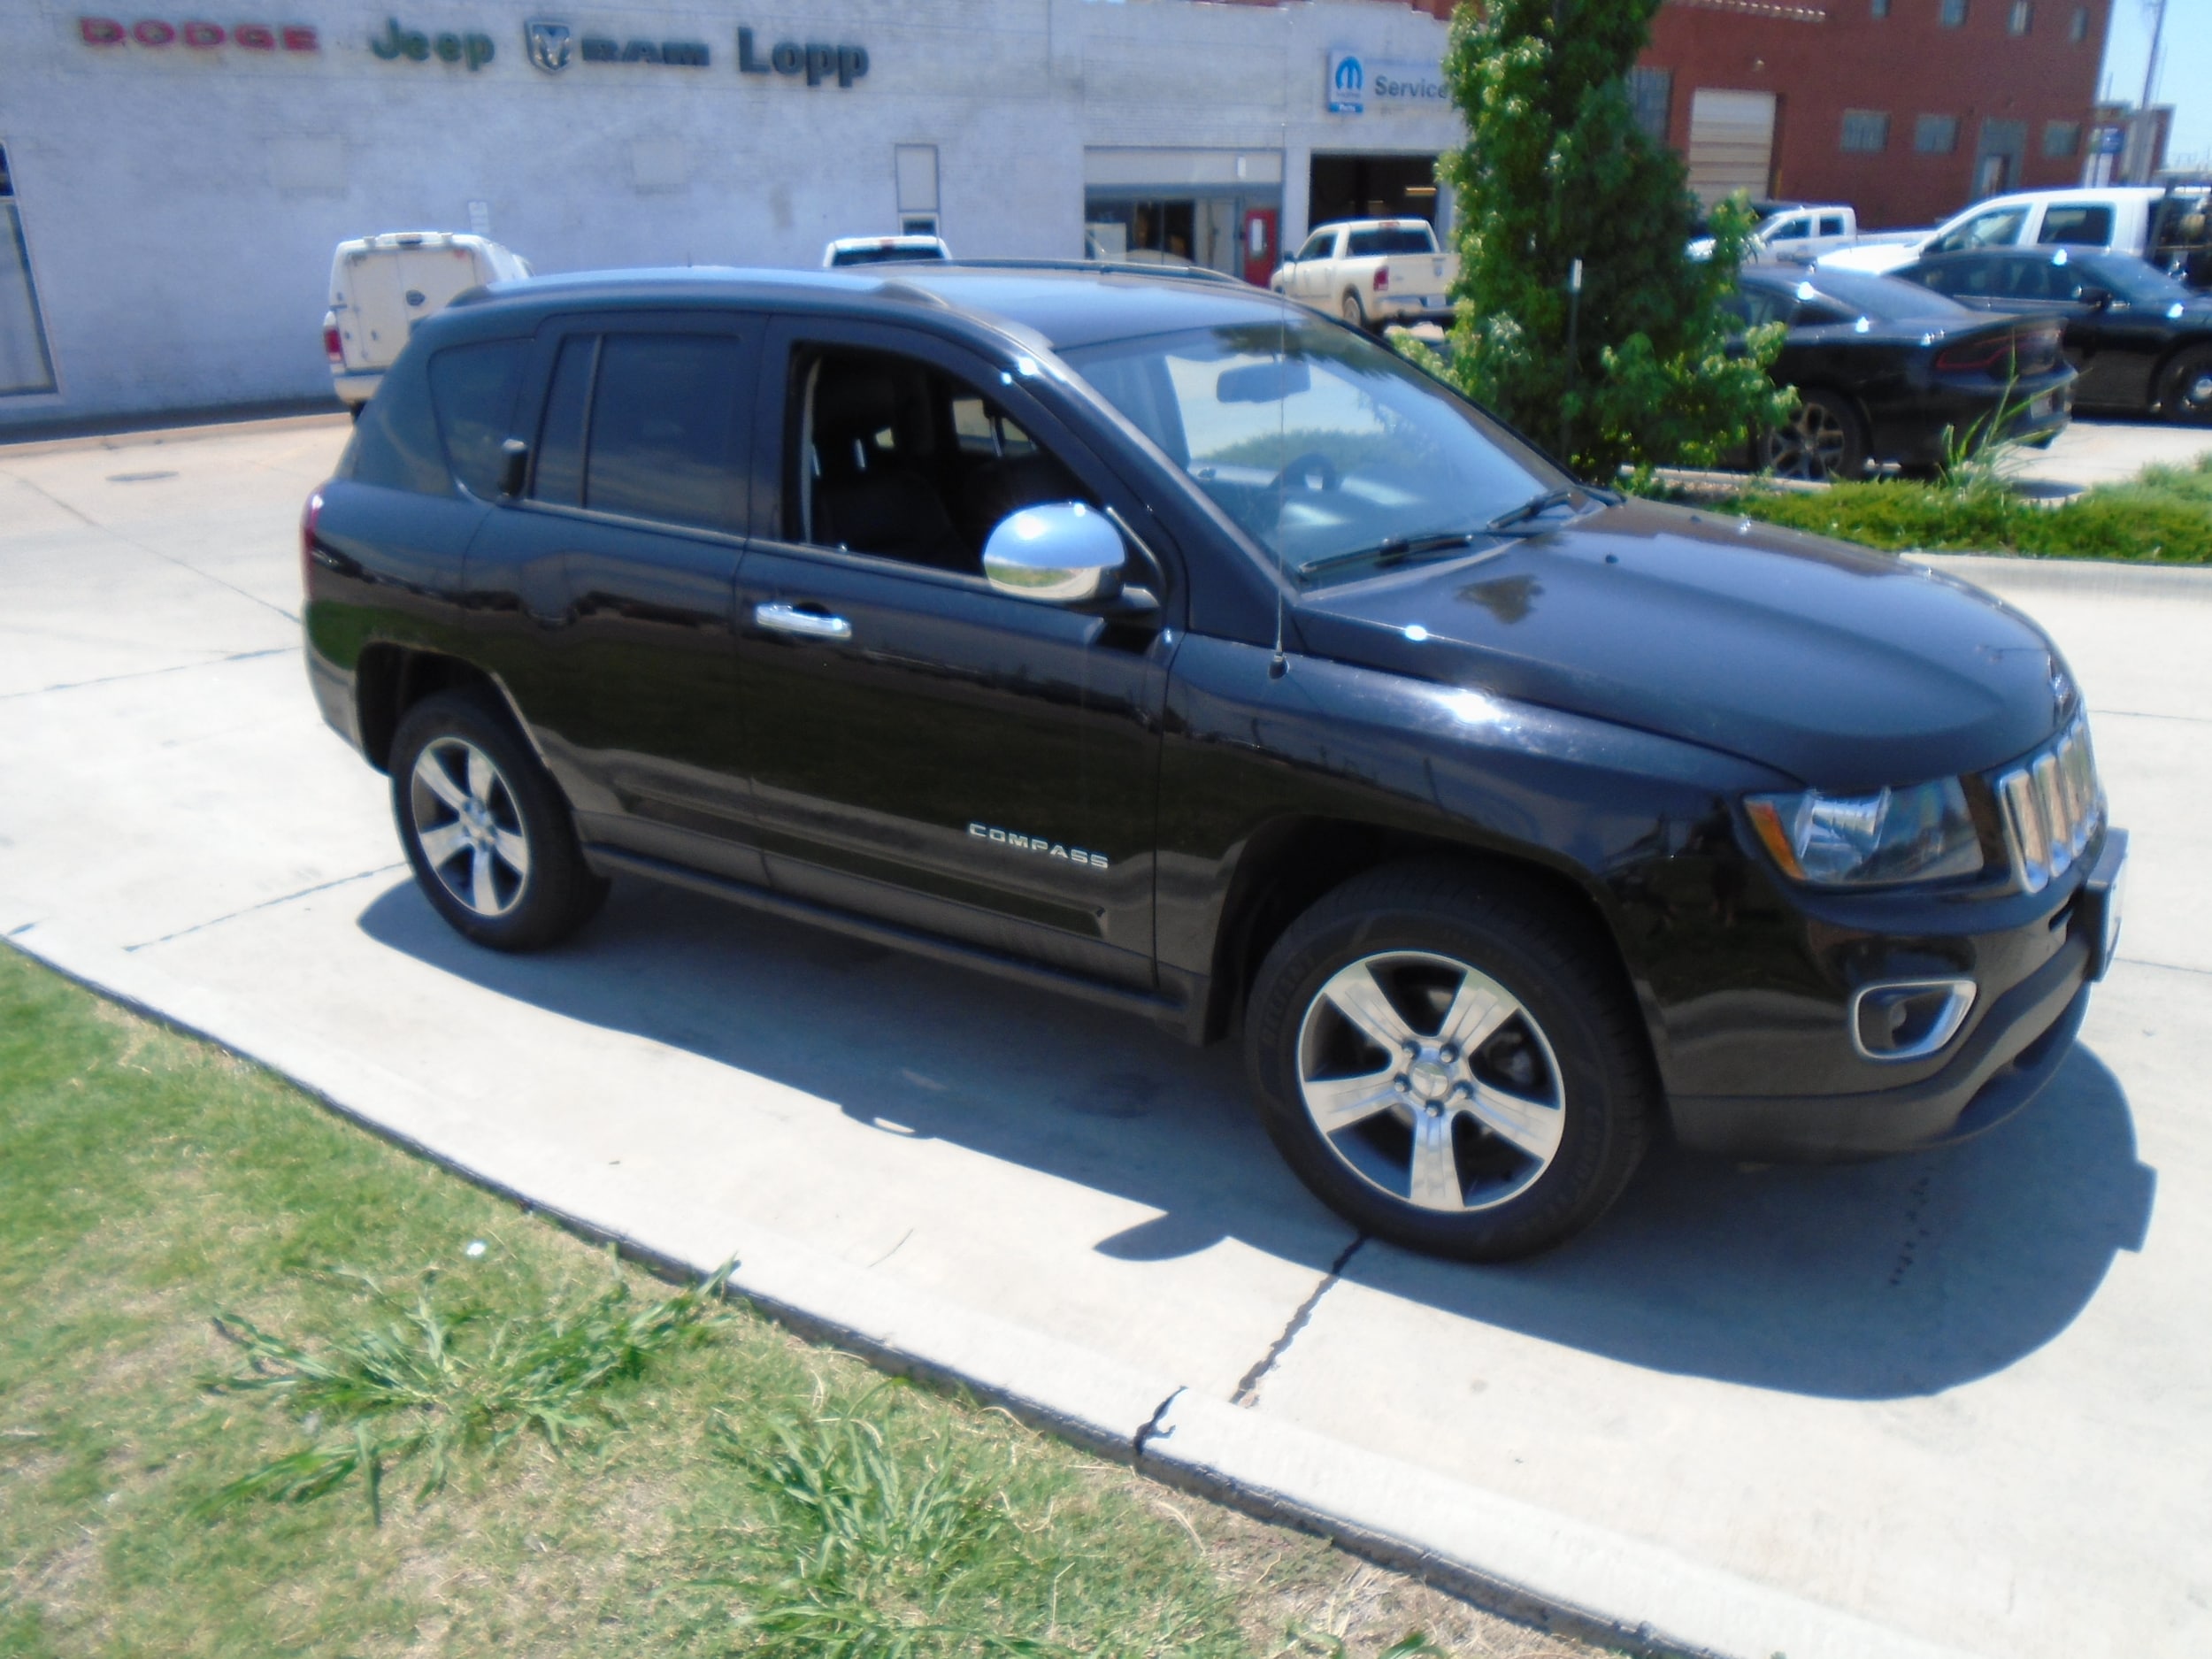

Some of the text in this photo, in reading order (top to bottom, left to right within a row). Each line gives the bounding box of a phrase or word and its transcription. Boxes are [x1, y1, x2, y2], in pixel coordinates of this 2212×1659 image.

[79, 17, 869, 88] DODGE Jeep RAM Lopp
[1374, 75, 1449, 99] Service
[969, 822, 1109, 870] COMPASS
